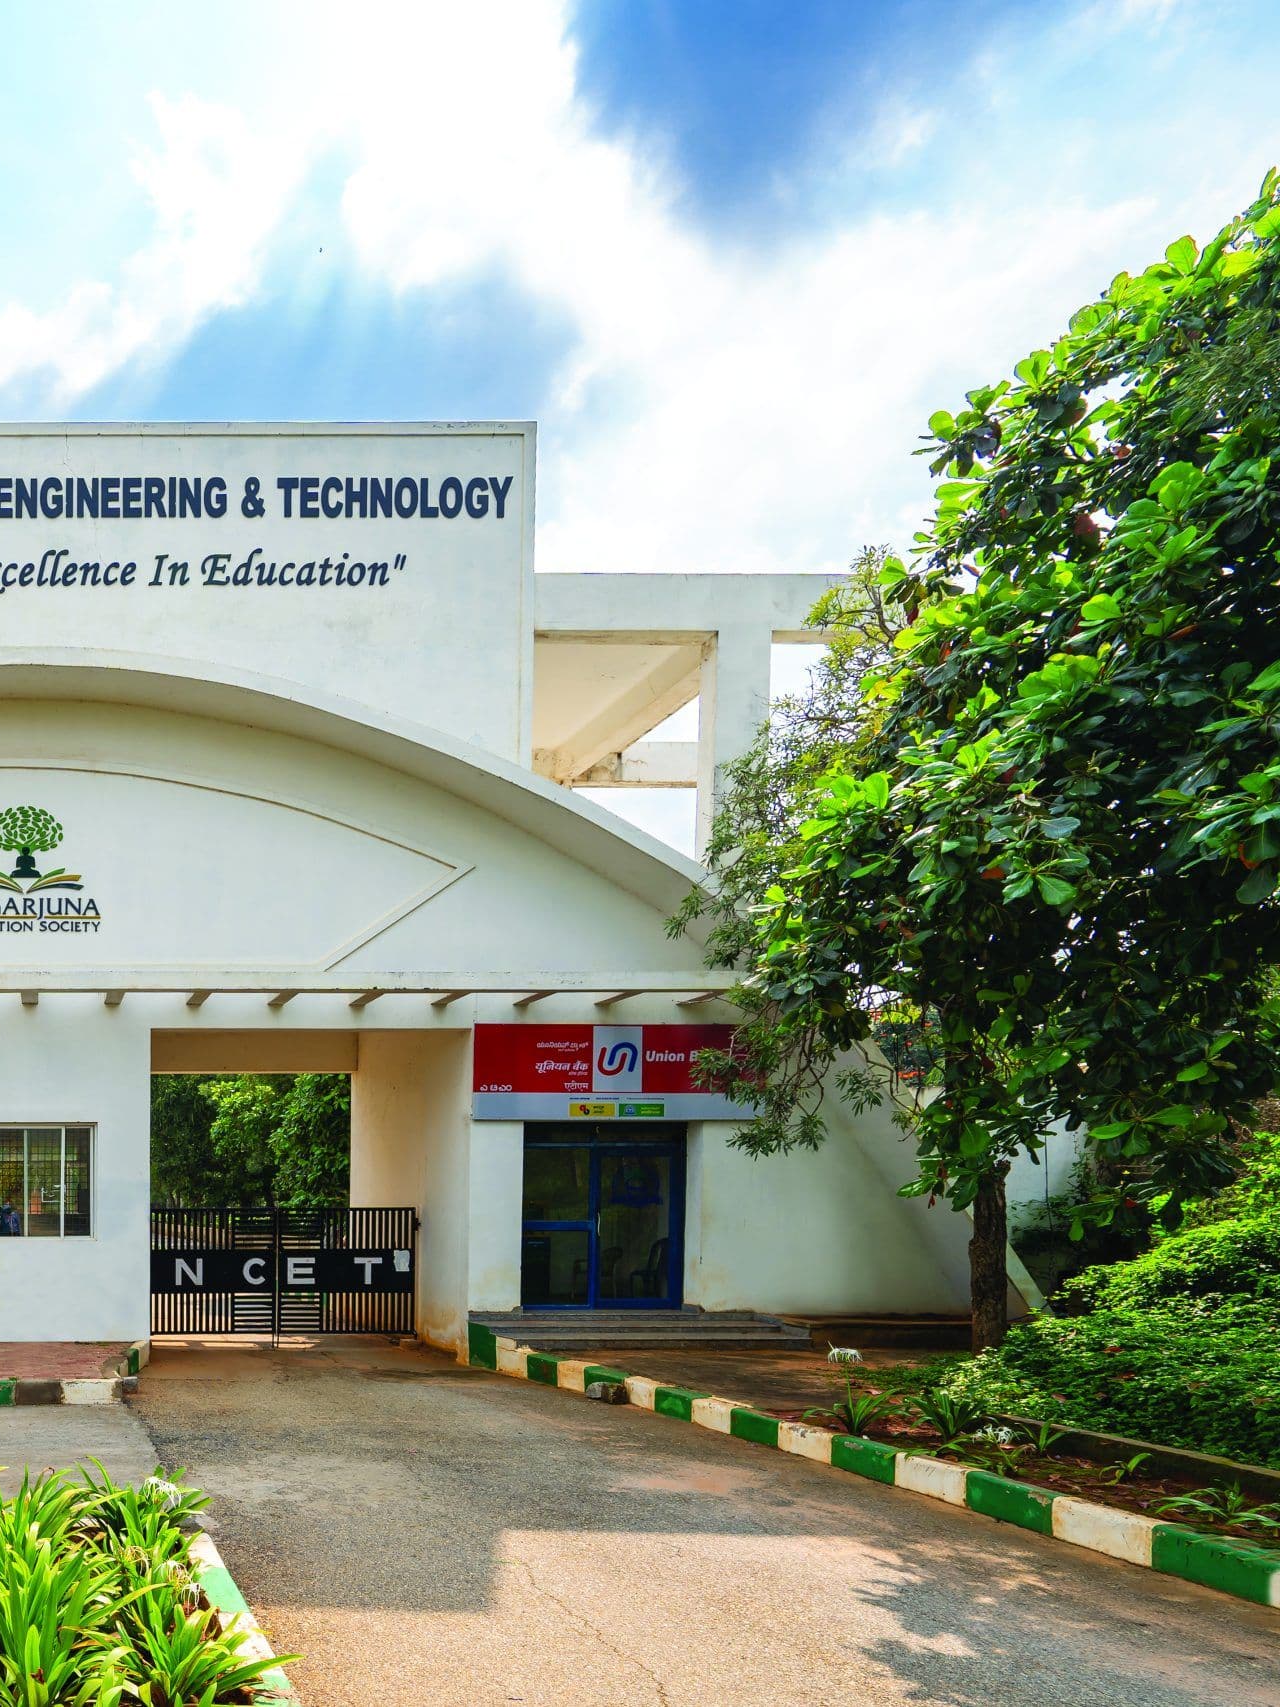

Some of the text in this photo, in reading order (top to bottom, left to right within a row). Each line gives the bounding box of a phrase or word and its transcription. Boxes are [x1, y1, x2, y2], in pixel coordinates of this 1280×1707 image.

[240, 476, 266, 518] &
[276, 475, 514, 519] TECHNOLOGY
[148, 554, 190, 587] In
[200, 548, 407, 587] Education"
[39, 920, 101, 932] SOCIETY
[645, 1050, 685, 1062] Union
